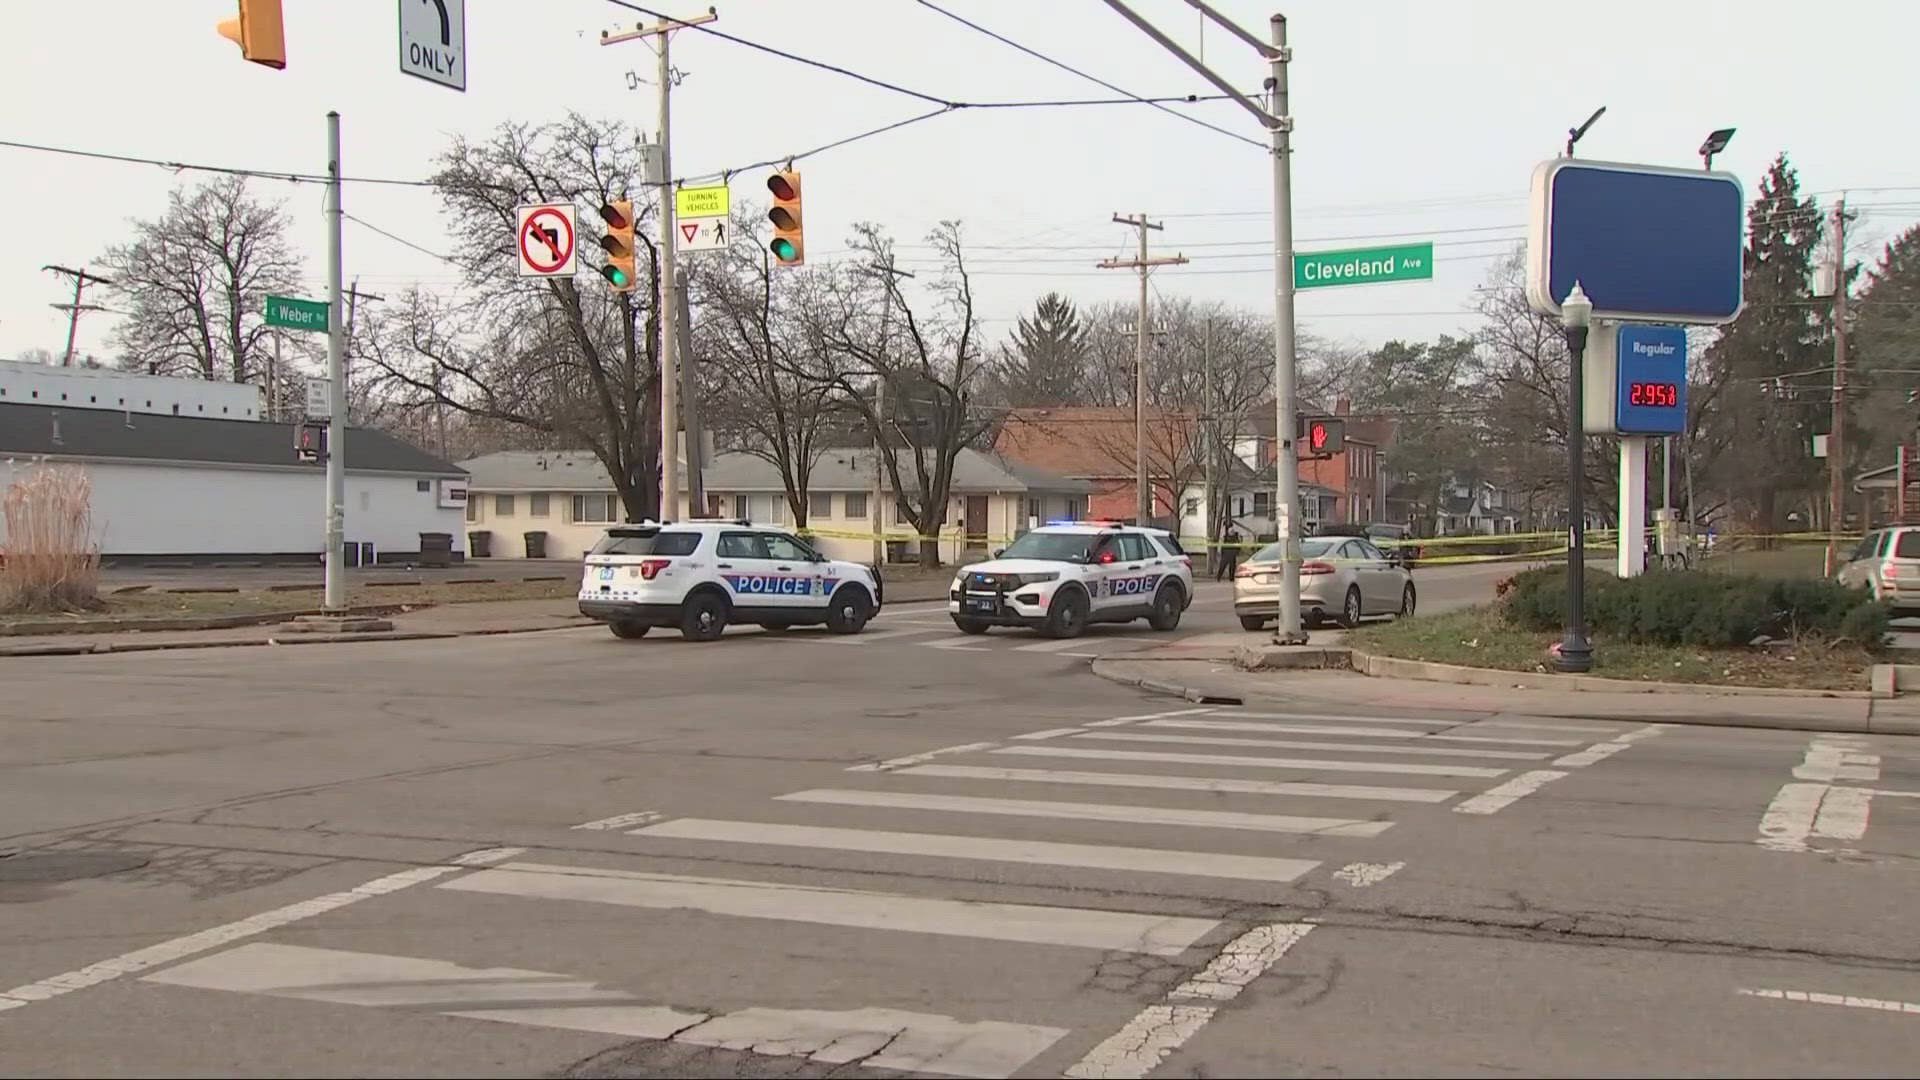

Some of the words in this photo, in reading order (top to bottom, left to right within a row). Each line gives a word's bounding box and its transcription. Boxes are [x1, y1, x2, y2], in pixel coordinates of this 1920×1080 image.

[410, 42, 455, 77] ONLY
[687, 192, 718, 202] TURNING
[686, 202, 719, 212] VEHICLES
[701, 229, 710, 237] TO
[1304, 255, 1395, 280] Cleveland
[1402, 258, 1422, 269] Ave
[279, 304, 313, 324] Weber
[1633, 341, 1675, 357] Regular
[737, 576, 805, 593] POLICE
